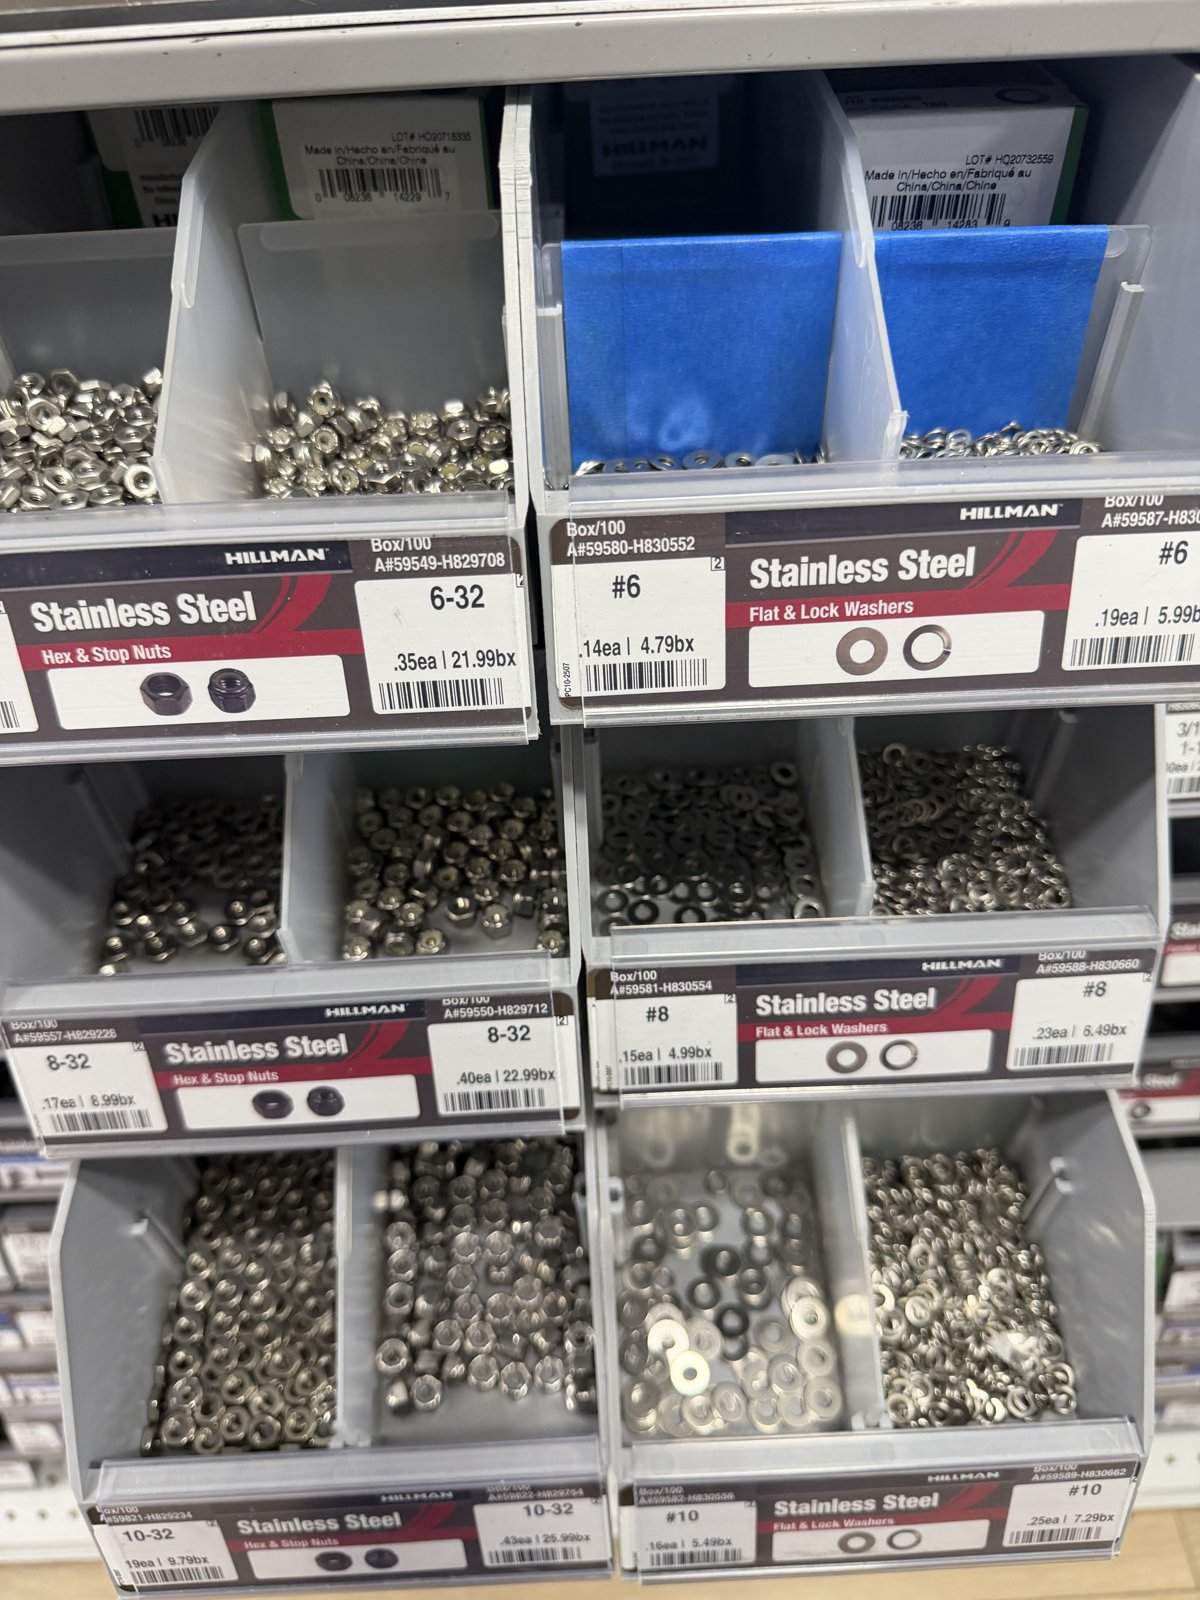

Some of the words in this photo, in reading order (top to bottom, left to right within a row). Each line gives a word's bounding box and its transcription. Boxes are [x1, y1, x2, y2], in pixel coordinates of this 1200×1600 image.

[305, 145, 332, 154] Made
[966, 154, 992, 166] LOT#
[994, 153, 1054, 166] HQ20732559
[865, 170, 895, 181] Made
[897, 168, 947, 181] in/Hecho
[950, 166, 1016, 181] en/Fabriqué
[1018, 168, 1032, 179] au
[896, 180, 998, 193] China/China/Chine
[960, 503, 1058, 520] HILLMAN
[566, 519, 626, 538] Box/100
[371, 537, 432, 552] Box/100
[566, 536, 695, 558] A#59580-H830552
[1159, 540, 1189, 565] #6
[224, 548, 326, 565] HILLMAN
[375, 553, 506, 573] A#59549-H829708
[750, 554, 889, 590] Stainless
[898, 546, 976, 581] Steel
[612, 573, 641, 599] #6
[430, 584, 485, 610] 6-32
[31, 599, 171, 633] Stainless
[177, 591, 257, 625] Steel
[749, 605, 780, 622] Flat
[783, 604, 796, 620] &
[800, 602, 839, 620] Lock
[844, 598, 915, 617] Washers
[1095, 607, 1139, 627] .19ea
[579, 639, 622, 658] .14ea
[640, 634, 695, 654] 4.79bx
[41, 649, 73, 666] Hex
[77, 647, 90, 662] &
[92, 646, 130, 664] Stop
[132, 644, 173, 660] Nuts
[394, 653, 438, 672] .35ea
[452, 648, 517, 669] 21.99bx
[921, 958, 1002, 971] HILLMAN
[610, 969, 657, 982] Box/100
[610, 980, 712, 996] A#59581-H830554
[1082, 980, 1107, 997] #8
[756, 992, 867, 1016] Stainless
[873, 987, 936, 1011] Steel
[325, 1004, 406, 1017] HILLMAN
[444, 1003, 549, 1020] A#59550-H829712
[646, 1006, 669, 1022] #8
[10, 1019, 58, 1031] Box/100
[756, 1025, 781, 1038] Flat
[783, 1024, 794, 1037] &
[797, 1023, 827, 1037] Lock
[831, 1021, 888, 1035] Washers
[1083, 1023, 1127, 1037] 6.49bx
[488, 1025, 532, 1043] 8-32
[165, 1040, 280, 1065] Stainless
[284, 1033, 349, 1058] Steel
[668, 1045, 712, 1060] 4.99bx
[47, 1053, 92, 1071] 8-32
[173, 1074, 198, 1086] Hex
[202, 1073, 213, 1083] &
[215, 1071, 245, 1085] Stop
[247, 1070, 279, 1082] Nuts
[503, 1068, 556, 1082] 22.99bx
[927, 1471, 1000, 1483] HILLMAN
[1068, 1483, 1102, 1497] #10
[523, 1502, 574, 1517] 10-32
[774, 1498, 876, 1517] Stainless
[882, 1492, 939, 1511] Steel
[237, 1517, 340, 1535] Stainless
[344, 1511, 402, 1531] Steel
[666, 1508, 699, 1523] #10
[1074, 1512, 1116, 1524] 7.29bx
[773, 1521, 797, 1531] Flat
[811, 1519, 840, 1529] Lock
[843, 1518, 896, 1528] Washers
[122, 1528, 175, 1542] 10-32
[243, 1540, 267, 1550] Hex
[281, 1538, 310, 1549] Stop
[312, 1537, 340, 1547] Nuts
